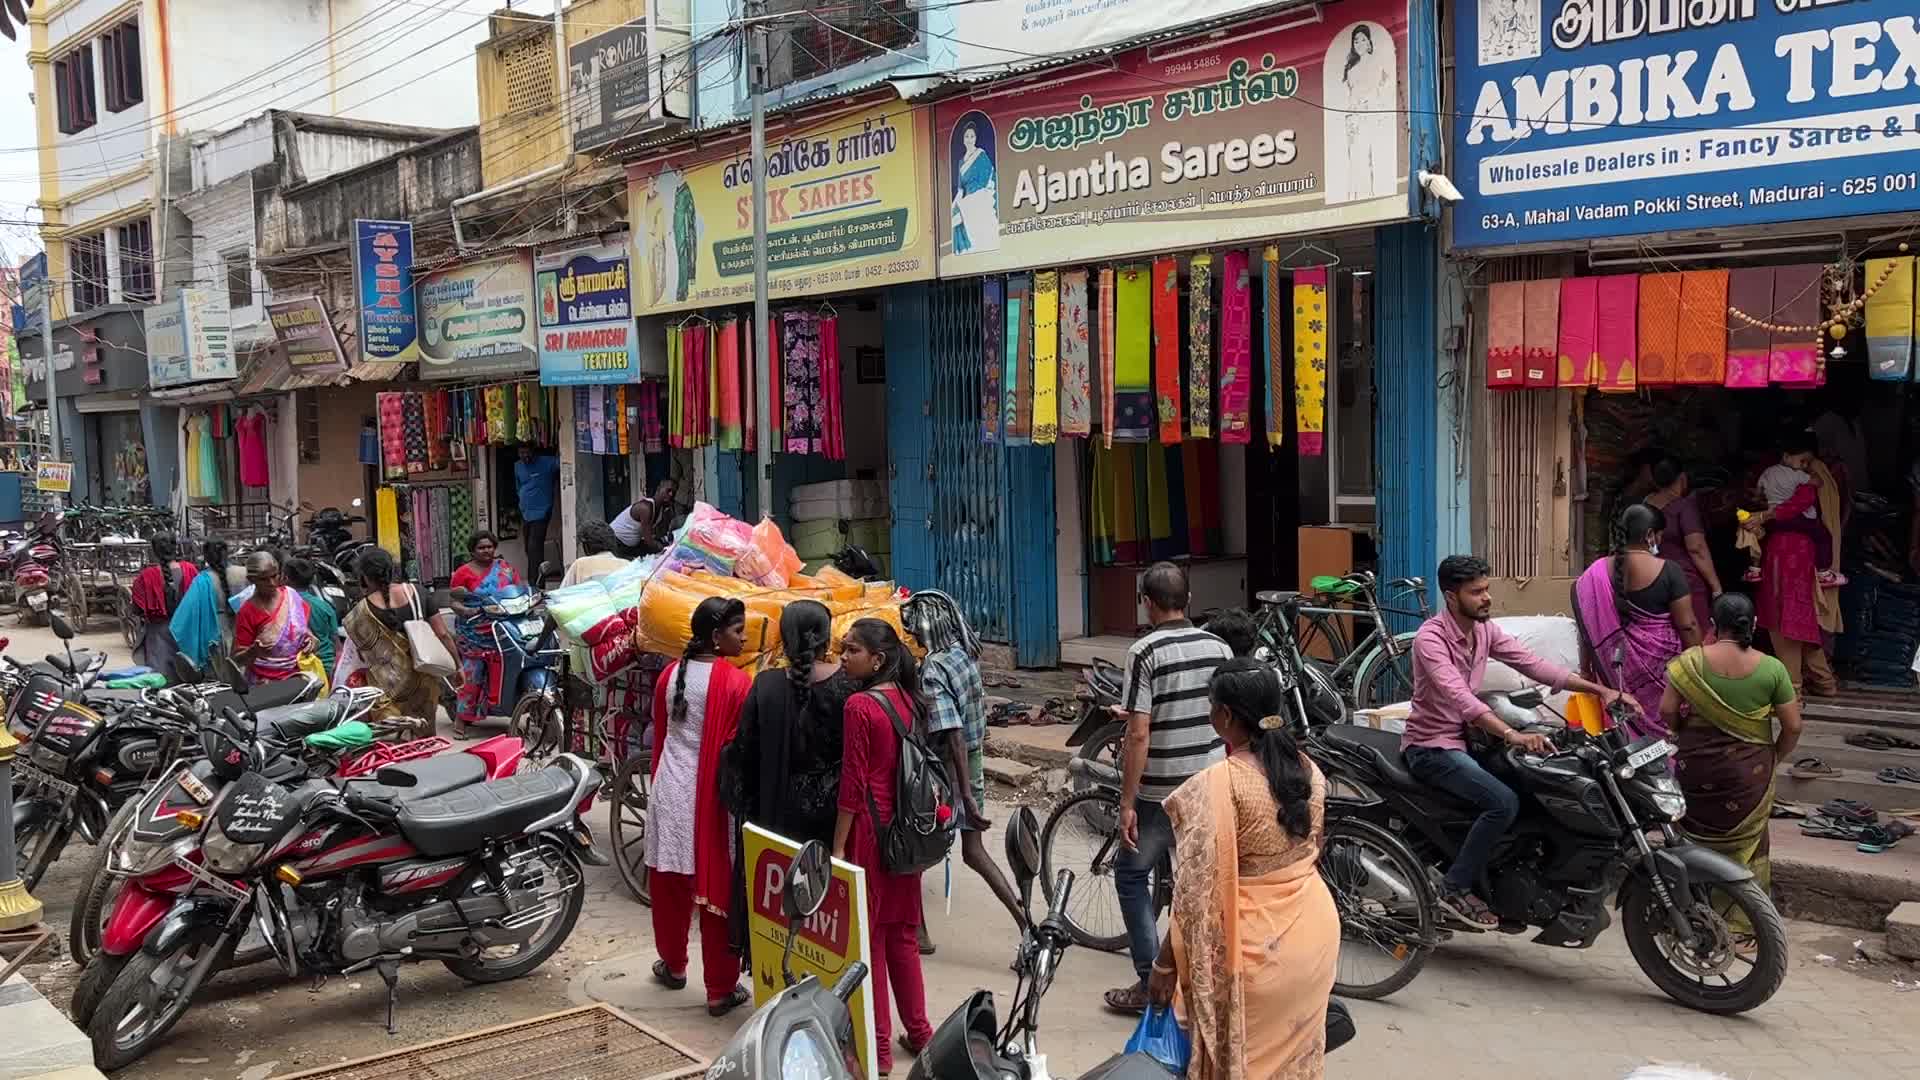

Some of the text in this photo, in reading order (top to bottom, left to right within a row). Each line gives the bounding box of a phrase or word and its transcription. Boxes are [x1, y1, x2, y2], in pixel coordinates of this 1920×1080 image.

[1165, 54, 1221, 76] 99944 54865
[1008, 53, 1298, 151] அஜந்தா சாரீஸ்
[1466, 44, 1756, 145] AMBIKA
[1012, 129, 1298, 213] Ajantha Sarees
[1489, 160, 1579, 184] Wholesale
[1585, 150, 1655, 173] Dealers
[1661, 148, 1679, 165] in
[1699, 134, 1779, 160] Fancy
[1789, 123, 1871, 149] Saree
[1882, 115, 1902, 138] &
[736, 175, 875, 230] SK SAREES
[1208, 184, 1251, 205] மொத்த
[1255, 172, 1317, 198] வியாபாரம்
[1482, 212, 1520, 230] 63-A,
[1524, 207, 1570, 226] Mahal
[1575, 202, 1629, 222] Vadam
[1634, 195, 1681, 214] Pokki
[1686, 190, 1744, 211] Street,
[1749, 182, 1824, 206] Madurai
[1843, 177, 1876, 197] 625
[1884, 173, 1917, 192] 001
[847, 230, 898, 250] வியாபாரம்
[544, 332, 564, 351] SRI
